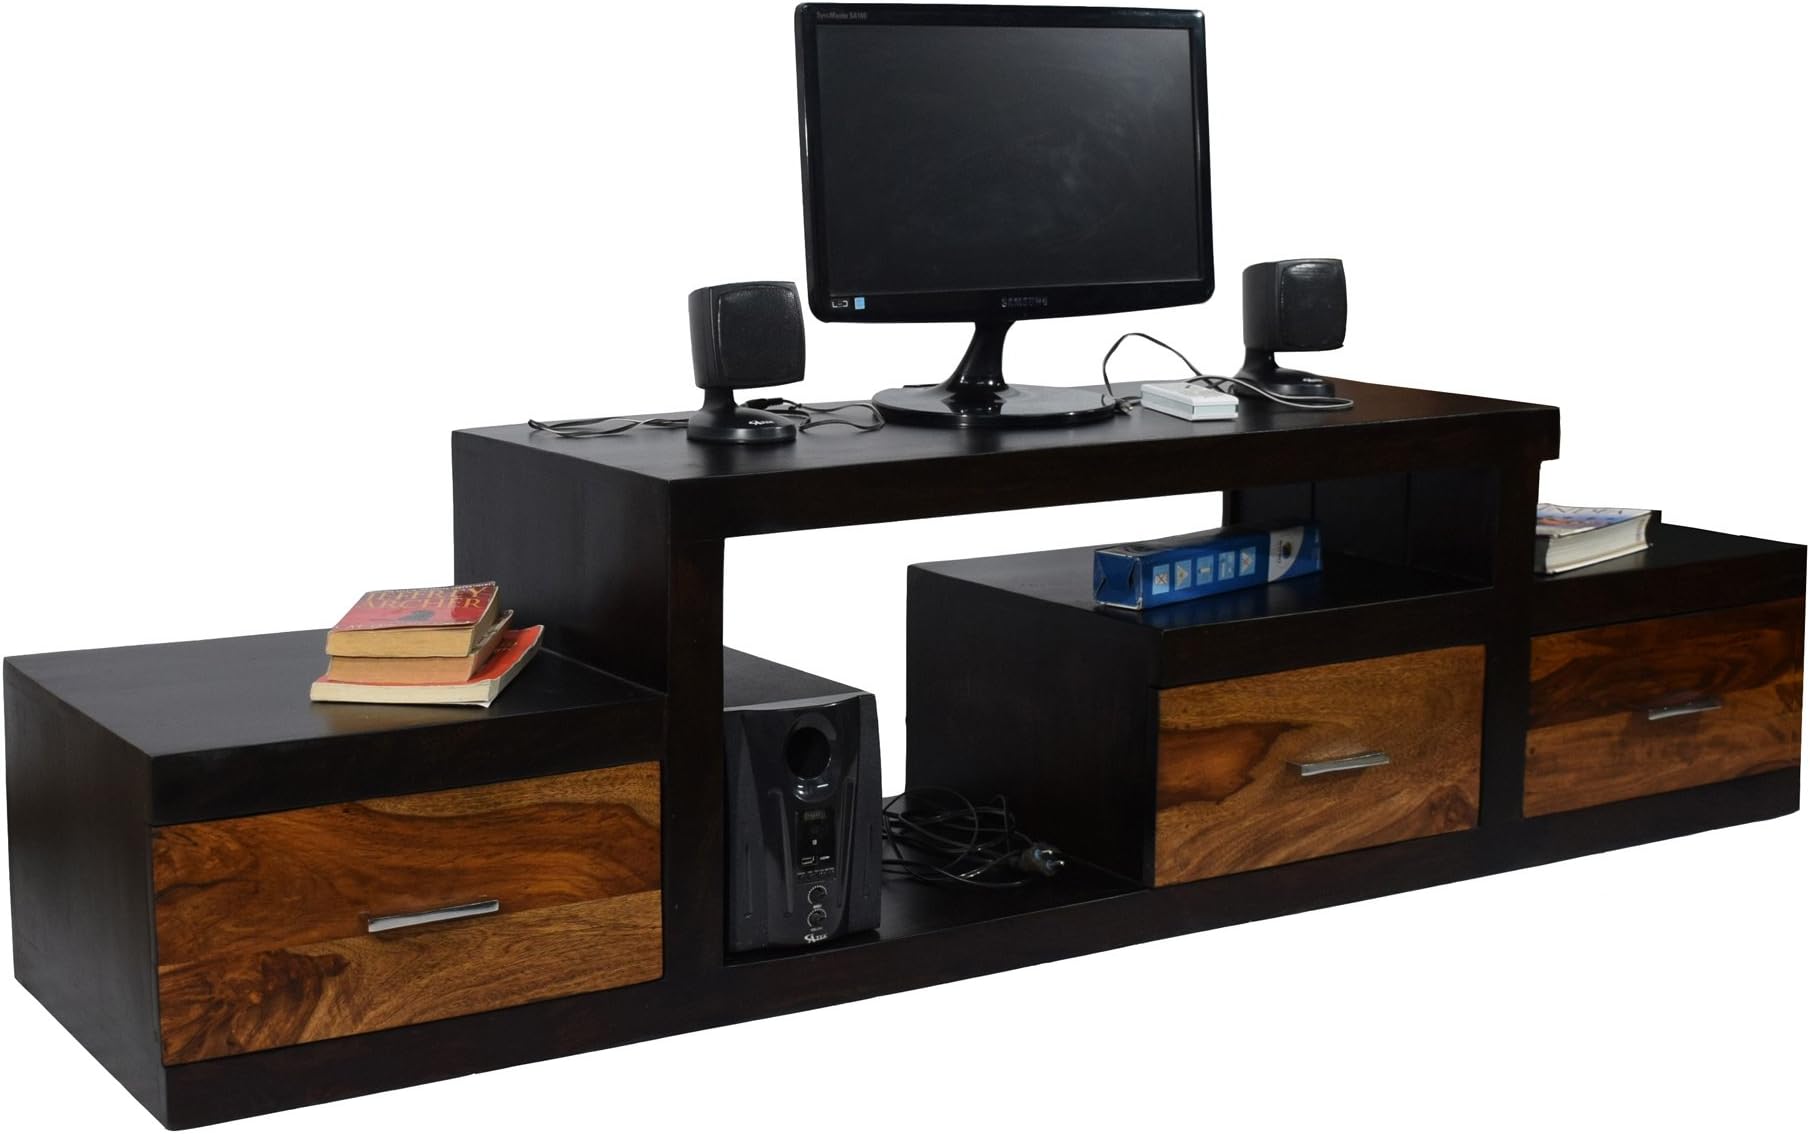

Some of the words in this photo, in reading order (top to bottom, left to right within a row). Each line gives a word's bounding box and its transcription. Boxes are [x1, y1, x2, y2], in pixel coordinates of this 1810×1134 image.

[1000, 296, 1048, 308] SAMSUNG
[367, 587, 487, 601] JEFFREY
[359, 597, 482, 609] ARCHER
